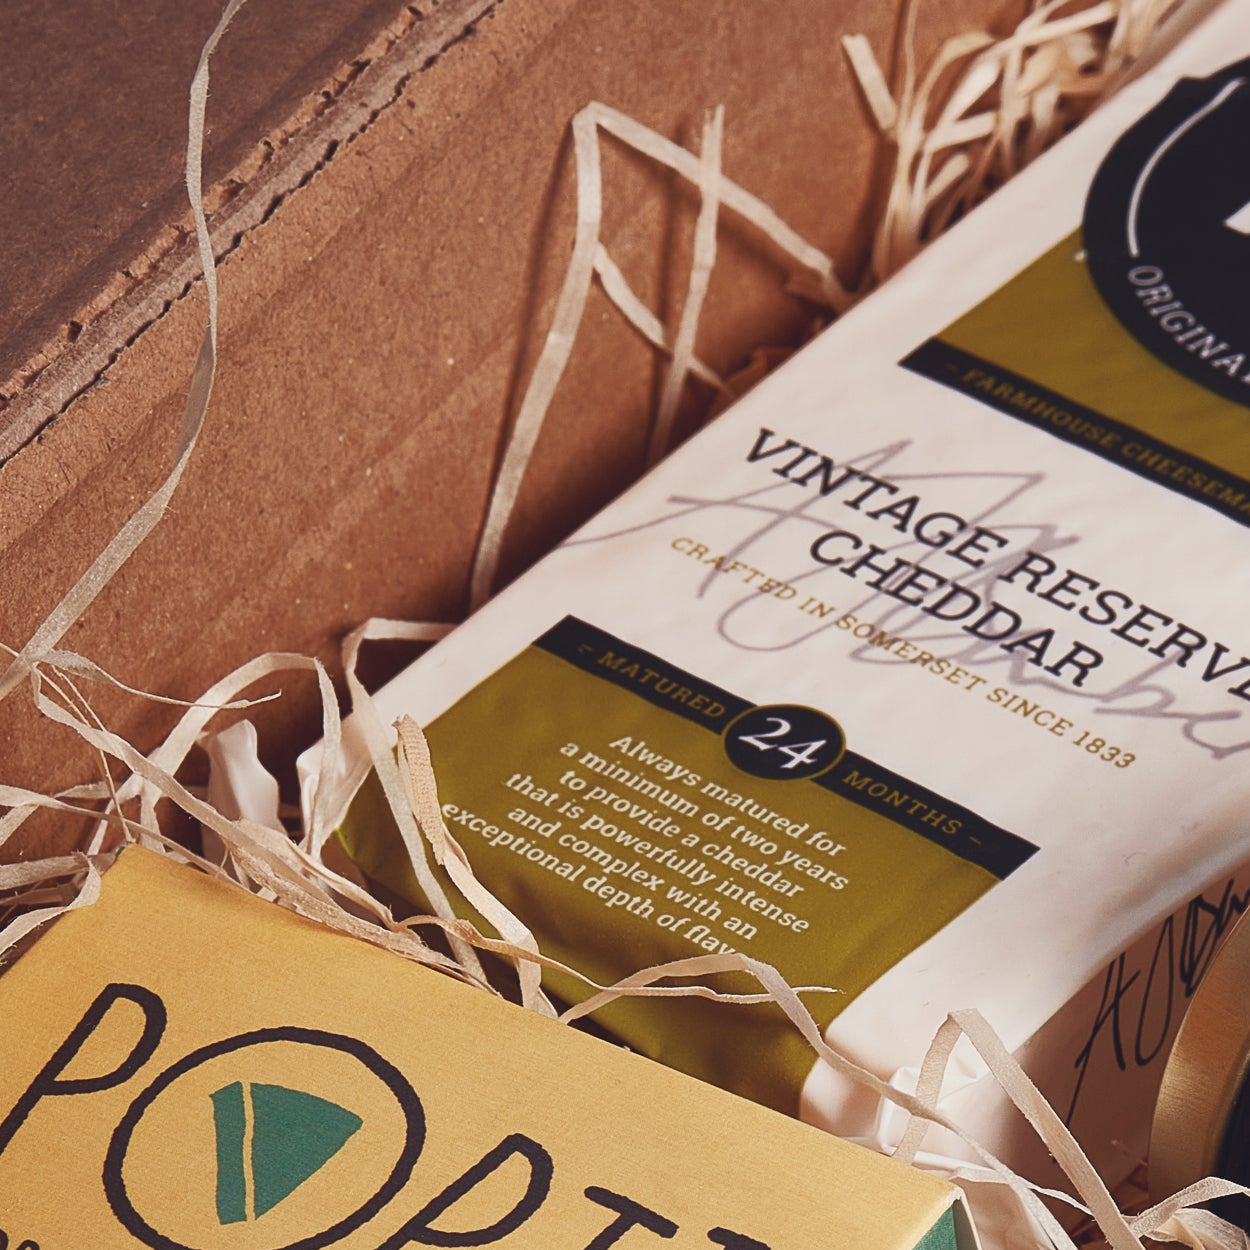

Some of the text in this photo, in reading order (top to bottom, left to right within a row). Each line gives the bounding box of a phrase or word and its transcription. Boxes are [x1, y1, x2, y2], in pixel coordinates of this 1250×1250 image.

[960, 364, 1118, 449] FARMHOUSE
[742, 427, 1008, 569] VINTAGE
[668, 535, 797, 604] CRAFTED
[797, 596, 833, 621] IN
[834, 611, 990, 694] SOMERSET
[985, 685, 1075, 738] SINCE
[1071, 729, 1137, 771] 1833
[808, 529, 1105, 688] CHEDDAR
[596, 650, 726, 720] MATURED
[739, 716, 828, 770] 24
[505, 773, 809, 933] that is powerfully intense
[559, 770, 804, 898] to provide a cheddar
[560, 742, 849, 891] a minimum of two years
[610, 735, 846, 857] Always matured for
[841, 768, 964, 838] MONTHS
[441, 804, 737, 955] exceptional depth of flav
[508, 806, 758, 941] and complex with an
